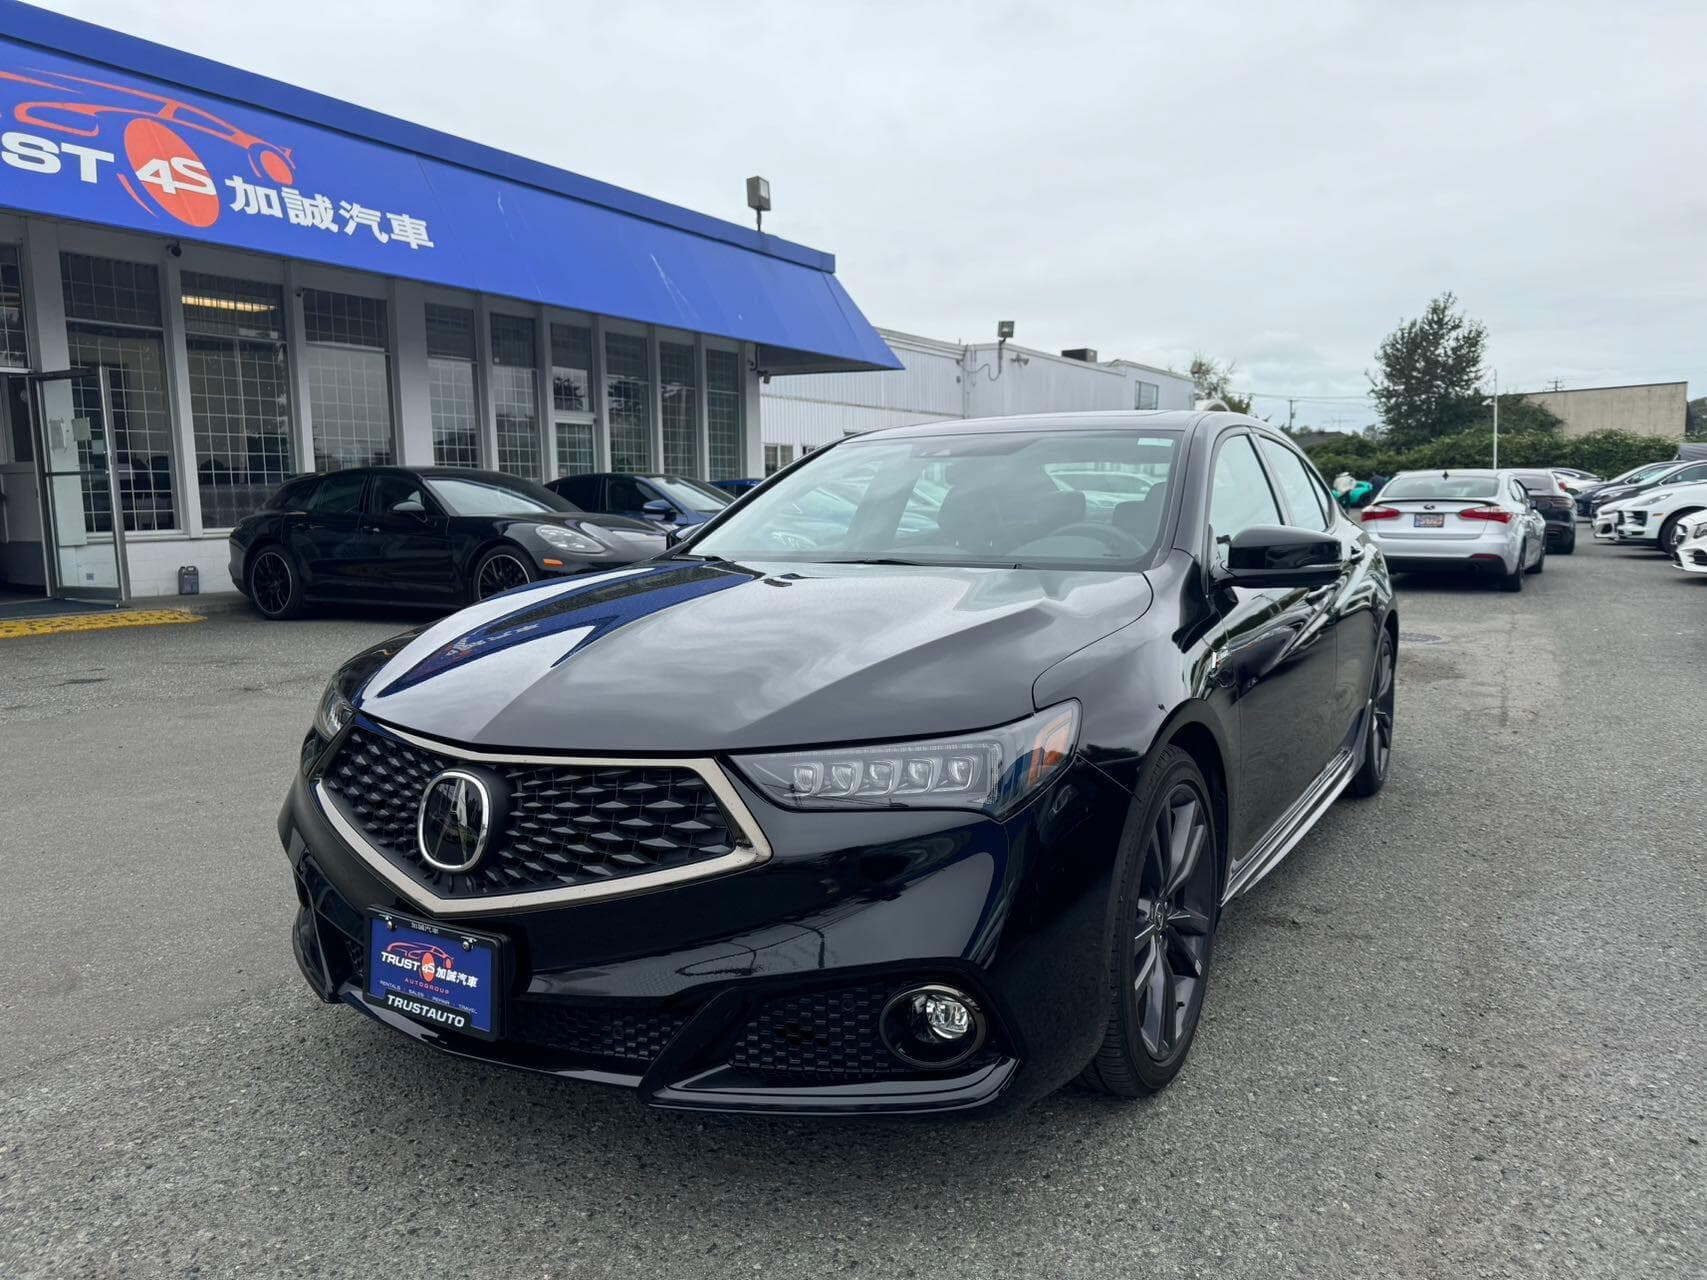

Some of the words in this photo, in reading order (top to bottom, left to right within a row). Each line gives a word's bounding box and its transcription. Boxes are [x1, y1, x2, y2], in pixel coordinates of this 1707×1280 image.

[136, 156, 218, 196] 4S
[225, 174, 434, 249] 加誠汽車
[381, 951, 420, 971] TRUST
[436, 967, 479, 988] 加誠汽車
[404, 977, 450, 995] AUTOGROUP
[387, 994, 465, 1028] TRUSTAUTO
